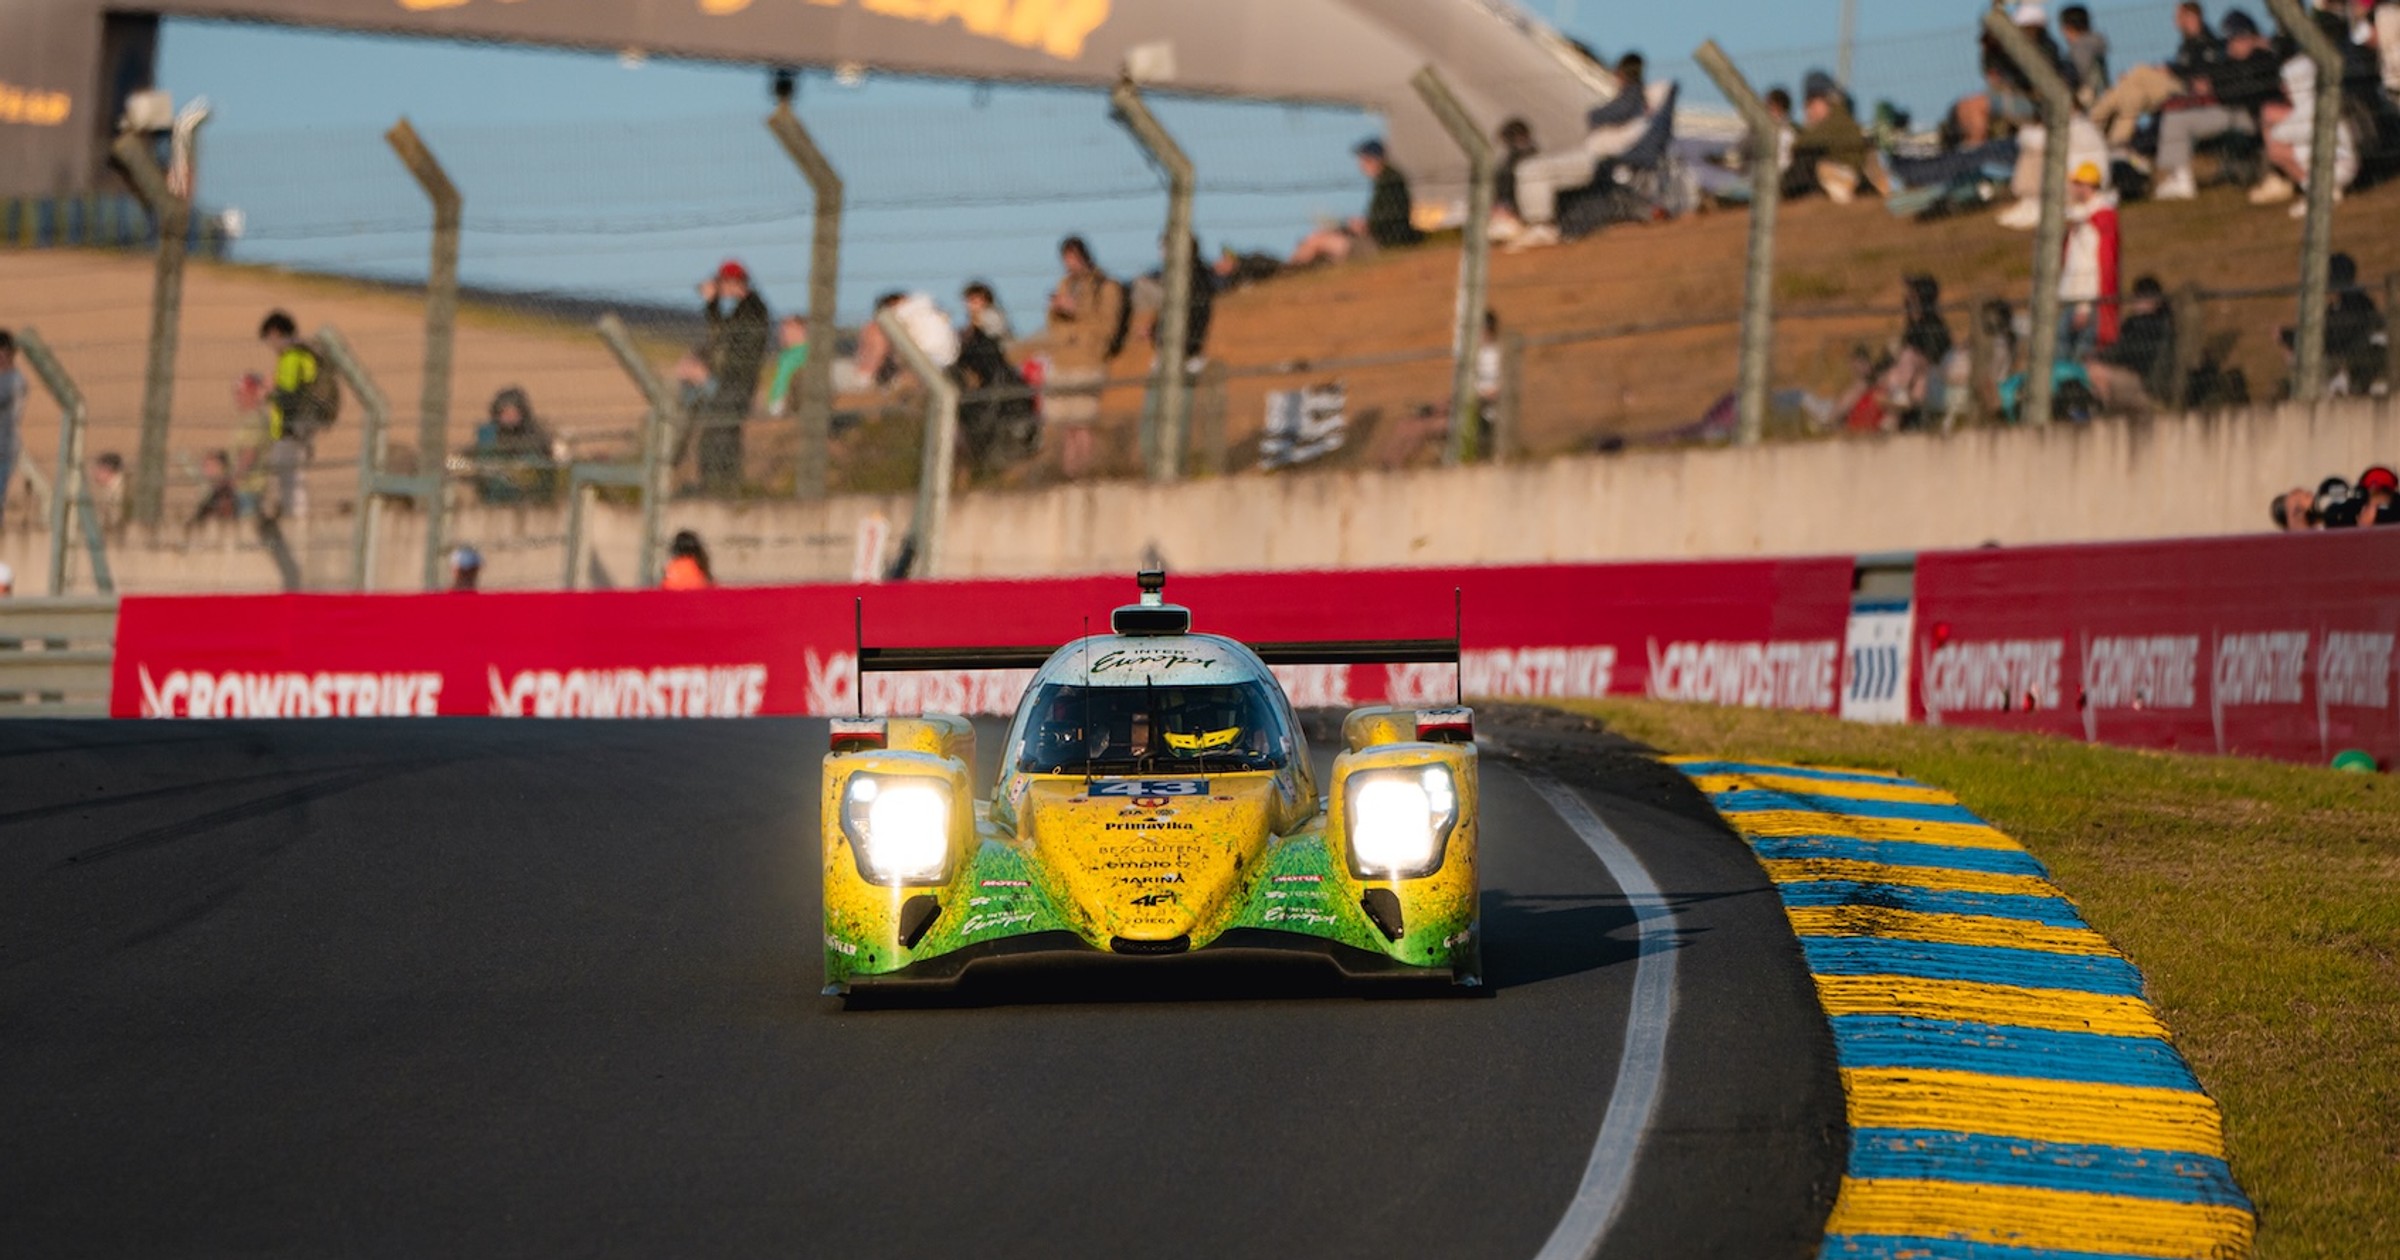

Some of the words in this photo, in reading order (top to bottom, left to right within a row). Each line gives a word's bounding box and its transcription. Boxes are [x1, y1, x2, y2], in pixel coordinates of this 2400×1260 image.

[160, 668, 443, 718] CROWDSTRIKE
[508, 663, 768, 718] CROWDSTRIKE
[1658, 639, 1838, 708] CROWDSTRIKE
[1929, 639, 2062, 709] CROWDSTRIKE
[1100, 781, 1198, 796] 43
[1105, 821, 1193, 831] Primavika
